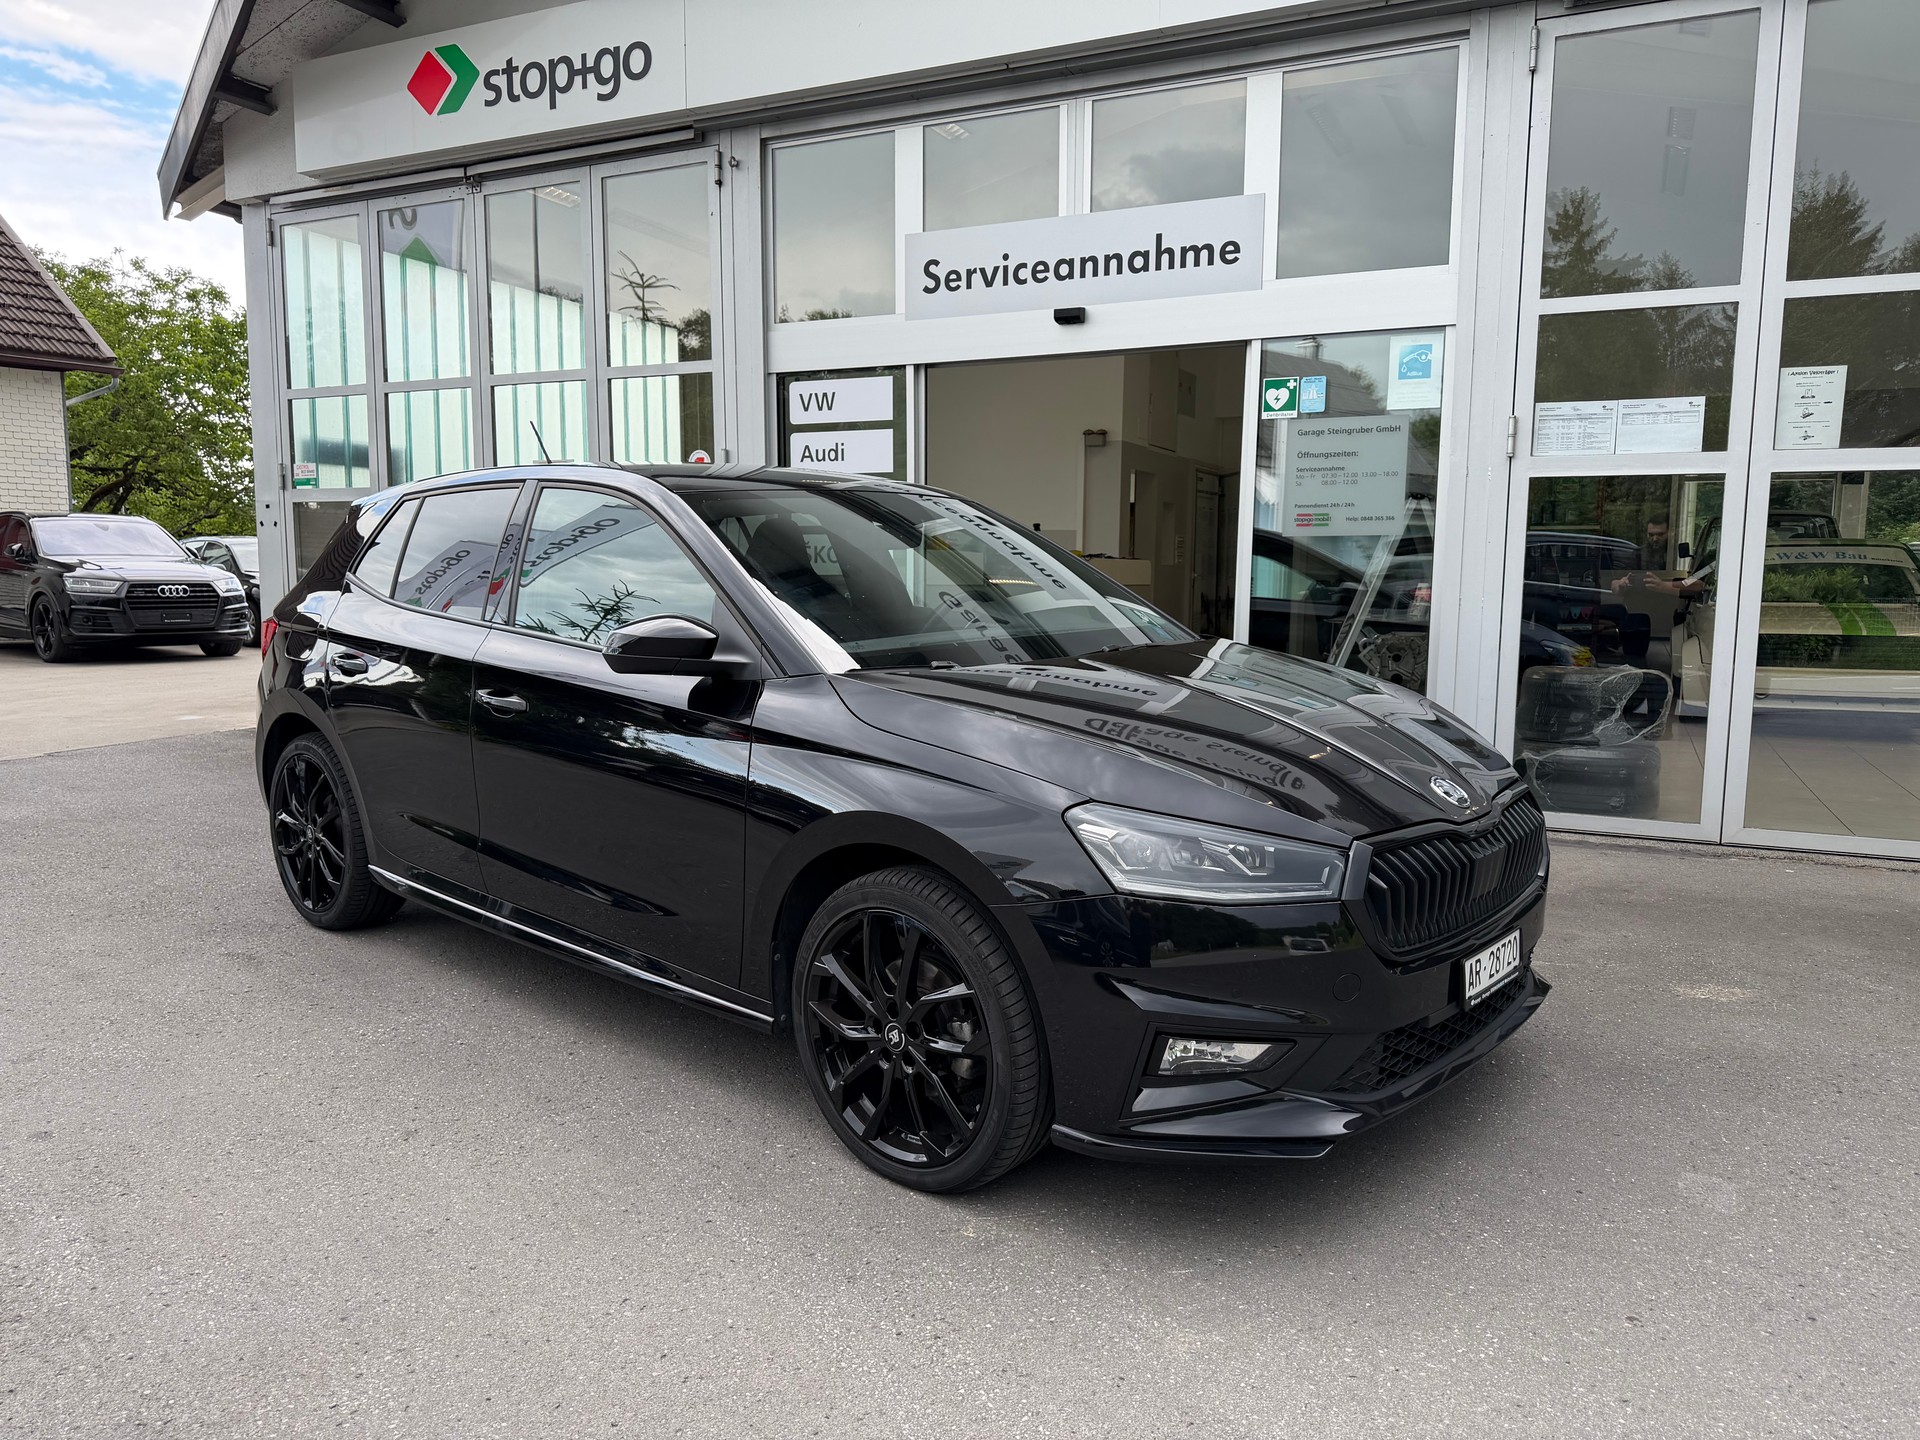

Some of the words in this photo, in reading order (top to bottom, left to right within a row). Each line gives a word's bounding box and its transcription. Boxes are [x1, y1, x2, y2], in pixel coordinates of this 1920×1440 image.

[484, 41, 652, 110] stop+go
[922, 233, 1241, 295] Serviceannahme
[798, 392, 836, 412] VW
[1297, 429, 1325, 437] Garage
[1327, 426, 1373, 436] Steingruber
[1375, 425, 1401, 433] GmbH
[801, 443, 845, 463] Audi
[1297, 450, 1359, 460] Öffnungszeiten:
[1296, 465, 1345, 473] Serviceannahme
